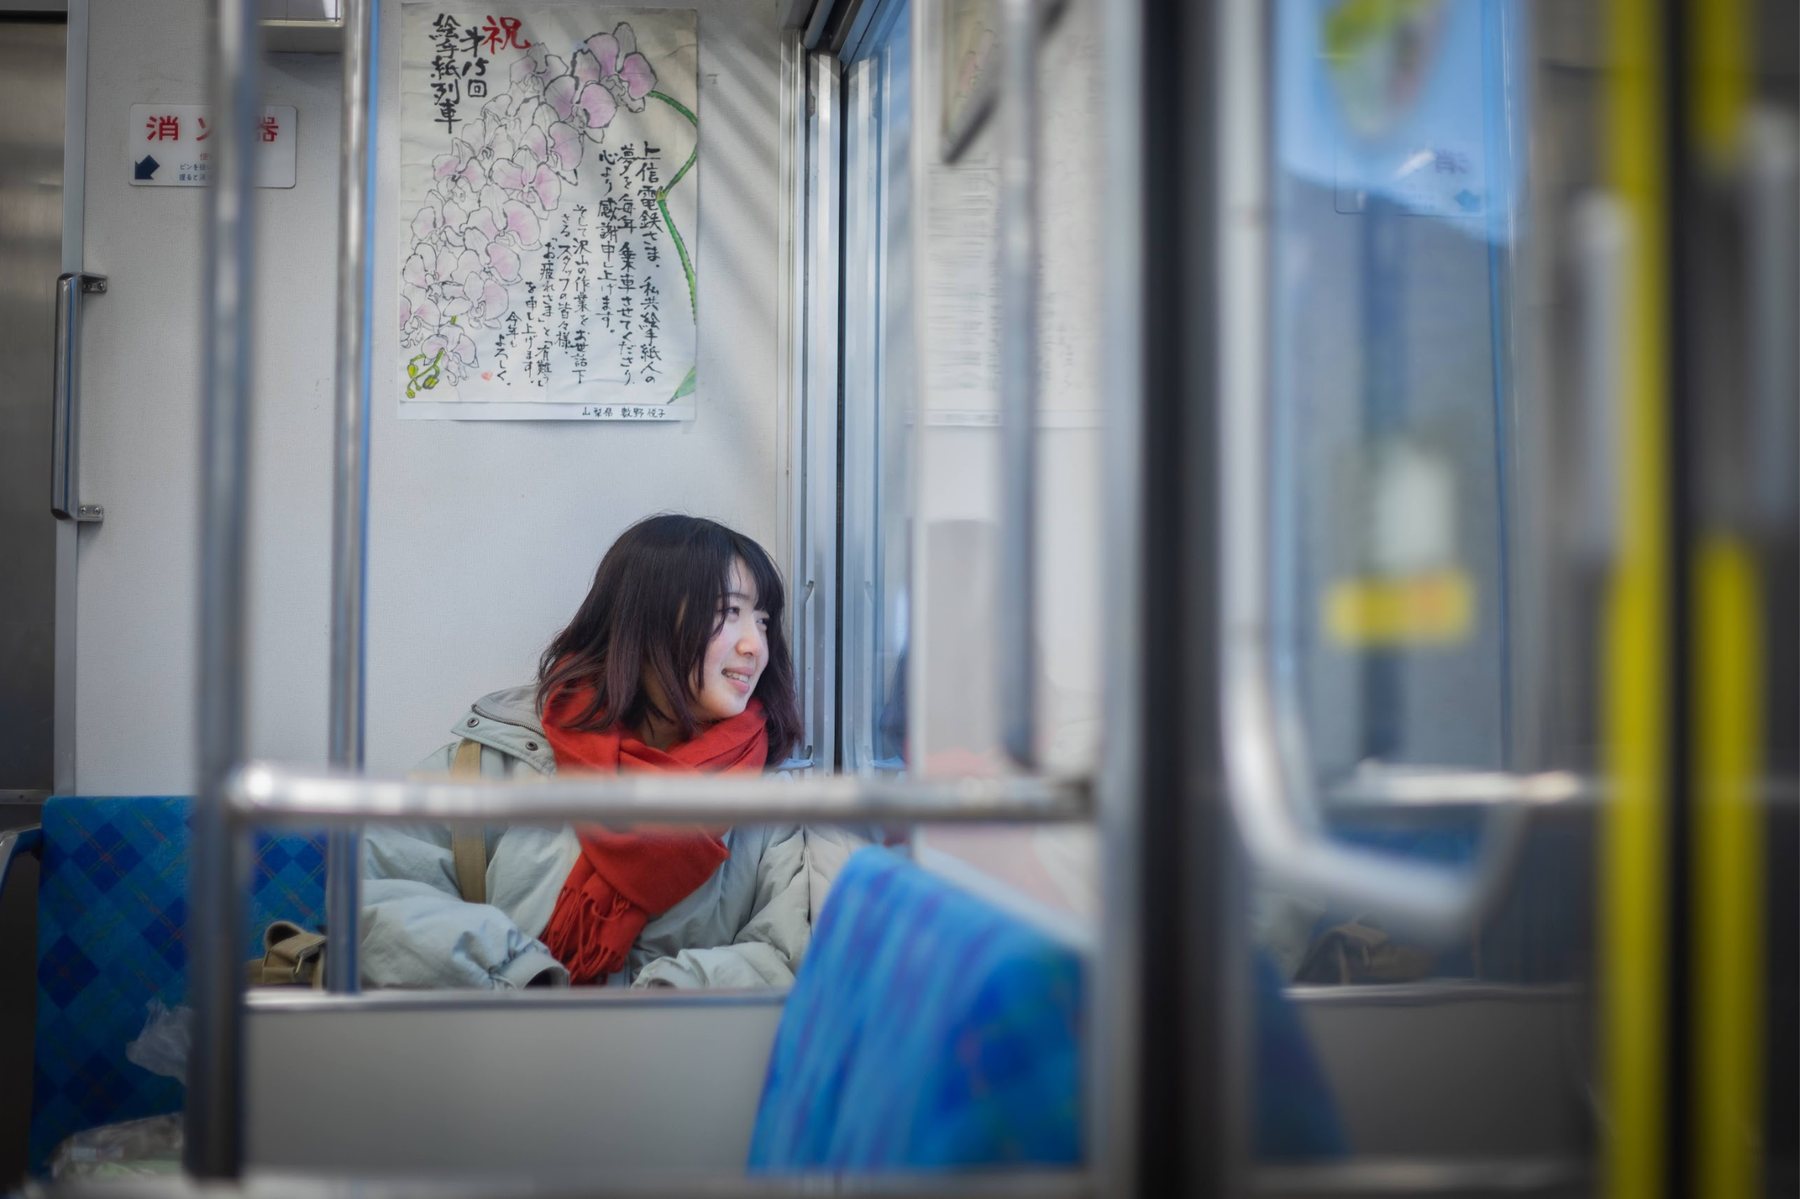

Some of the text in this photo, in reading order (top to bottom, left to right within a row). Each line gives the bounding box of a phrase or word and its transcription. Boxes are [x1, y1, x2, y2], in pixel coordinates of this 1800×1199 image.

[428, 13, 463, 134] 絵手紙列車
[481, 15, 531, 55] 祝
